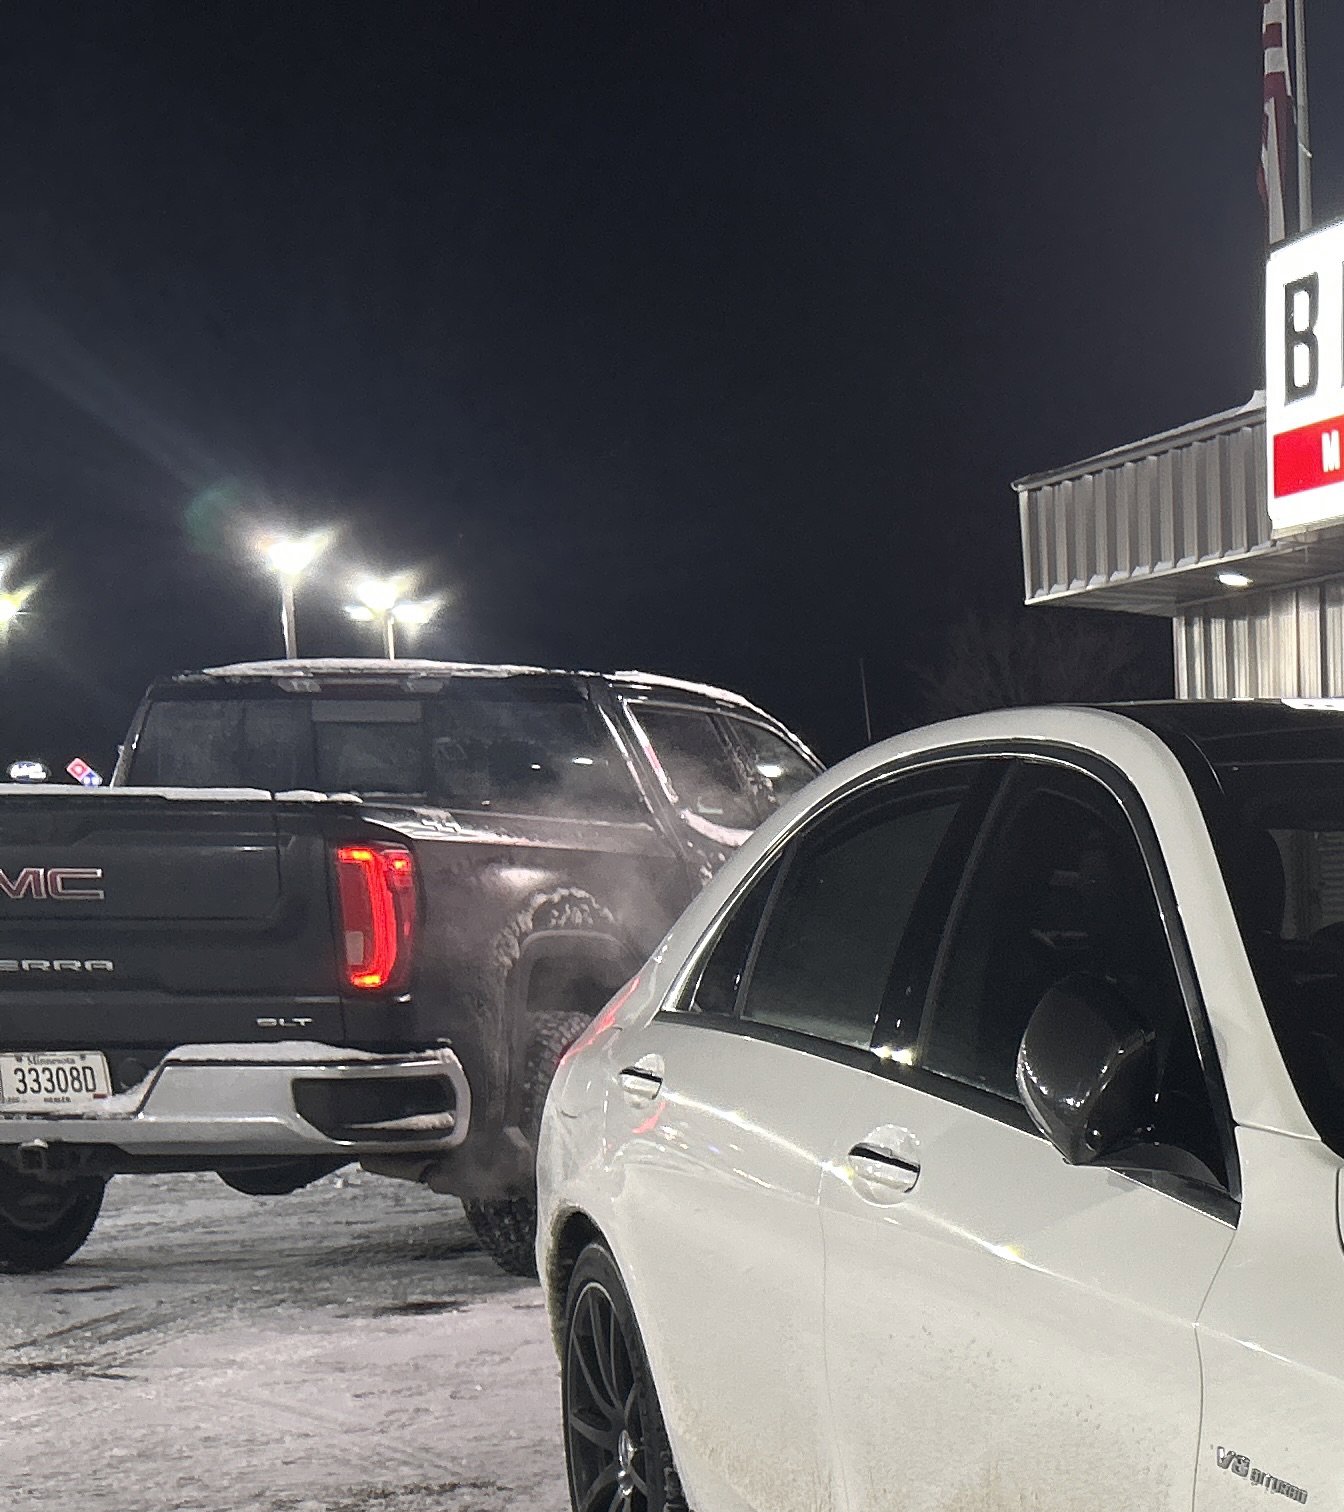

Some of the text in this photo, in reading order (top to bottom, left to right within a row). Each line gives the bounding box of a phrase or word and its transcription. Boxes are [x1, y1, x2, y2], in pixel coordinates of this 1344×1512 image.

[0, 868, 104, 899] MC
[0, 960, 114, 972] ERRA
[14, 1066, 97, 1094] 33308D
[1217, 1446, 1250, 1478] V8
